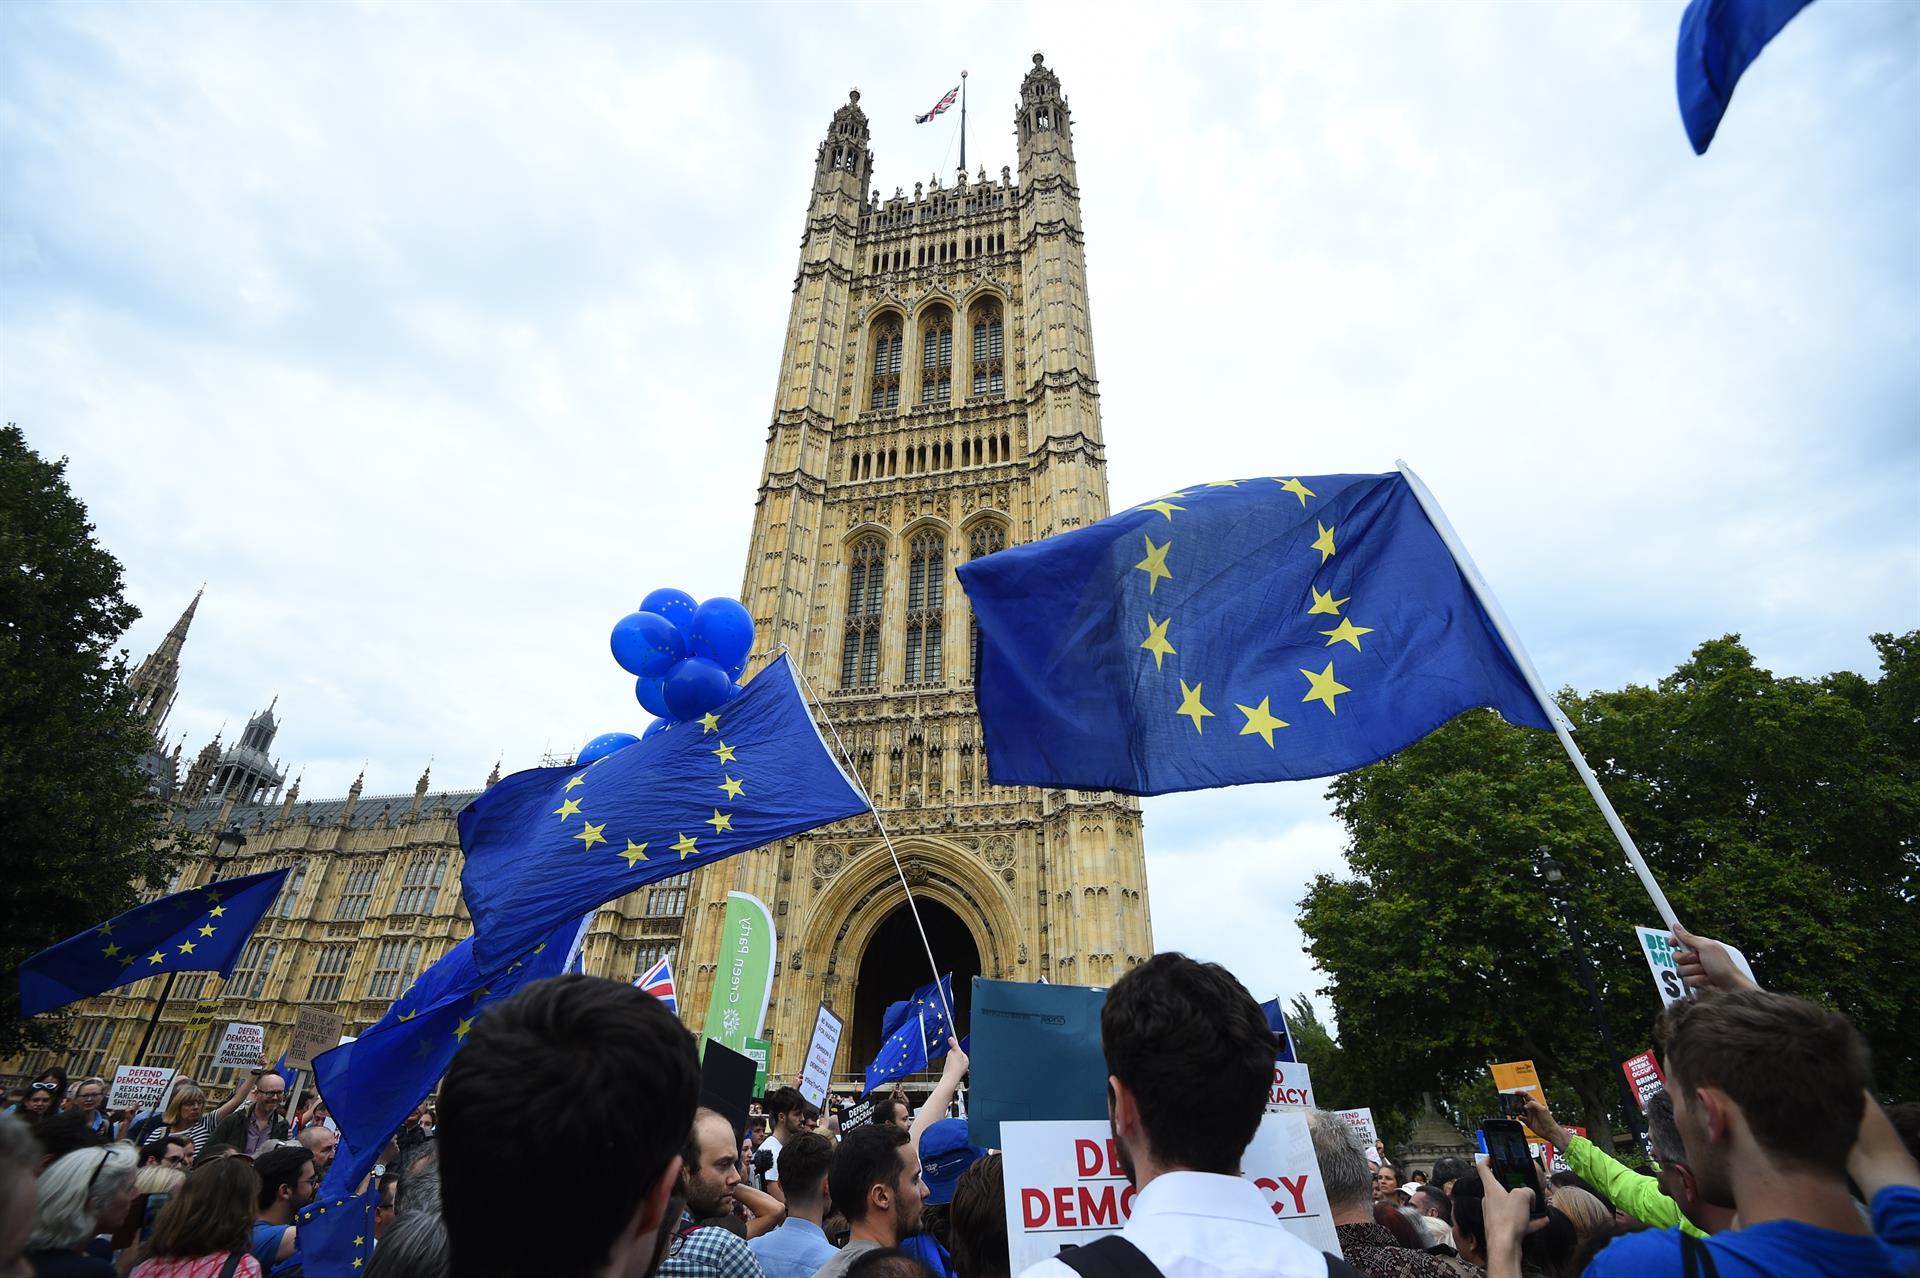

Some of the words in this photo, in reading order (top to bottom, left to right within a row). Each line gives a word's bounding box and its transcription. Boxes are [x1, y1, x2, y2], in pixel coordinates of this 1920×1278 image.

[238, 1027, 261, 1036] DEFEND
[226, 1034, 263, 1044] DEMOCRAC
[227, 1043, 248, 1051] RESIST
[1628, 1054, 1649, 1068] MARCH
[1631, 1061, 1651, 1072] STRIKE
[129, 1069, 163, 1078] DEFEND
[1631, 1065, 1655, 1079] OCCUPY
[1635, 1072, 1659, 1087] BRING
[119, 1085, 145, 1093] RESIST
[147, 1086, 163, 1095] THE
[1639, 1080, 1663, 1094] DOWN
[849, 1101, 870, 1118] DEFEND
[841, 1104, 877, 1131] DEMOCRACY
